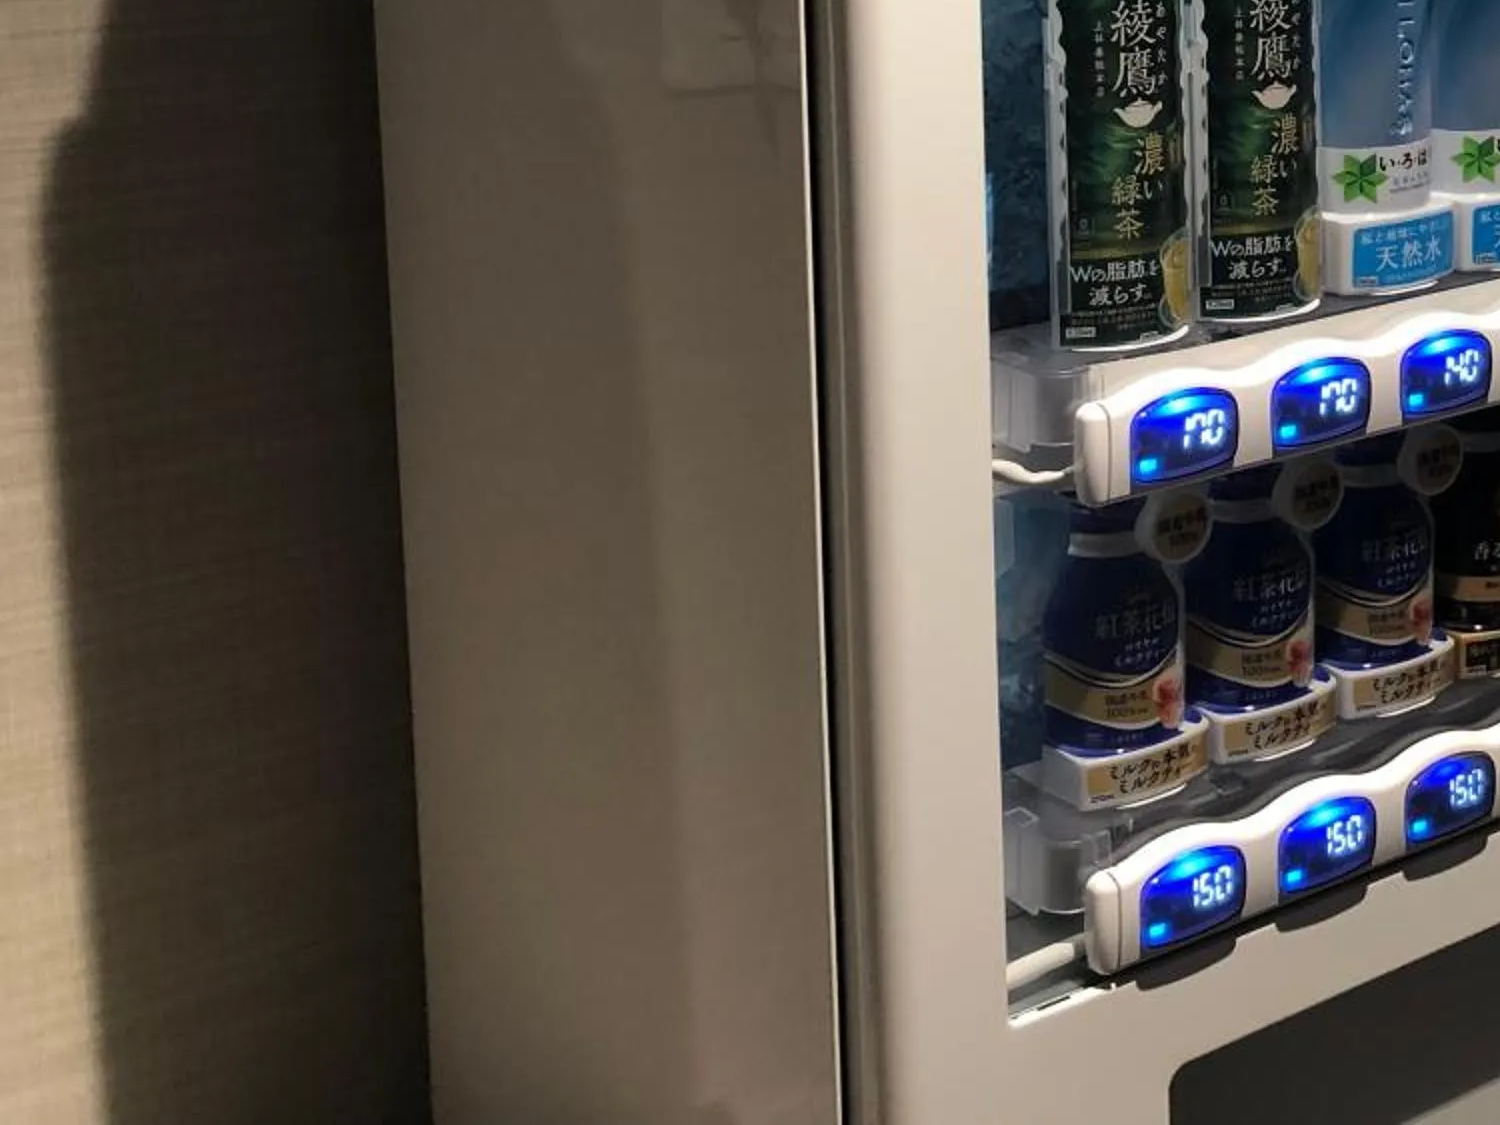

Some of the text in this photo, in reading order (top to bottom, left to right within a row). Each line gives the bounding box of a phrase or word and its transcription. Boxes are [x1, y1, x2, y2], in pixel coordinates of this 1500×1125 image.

[1374, 233, 1443, 273] 天然水
[1444, 348, 1480, 386] 140
[1320, 378, 1357, 416] 170
[1183, 408, 1226, 450] 170
[1449, 768, 1484, 807] 150
[1326, 814, 1363, 855] 150
[1192, 864, 1234, 909] 150
